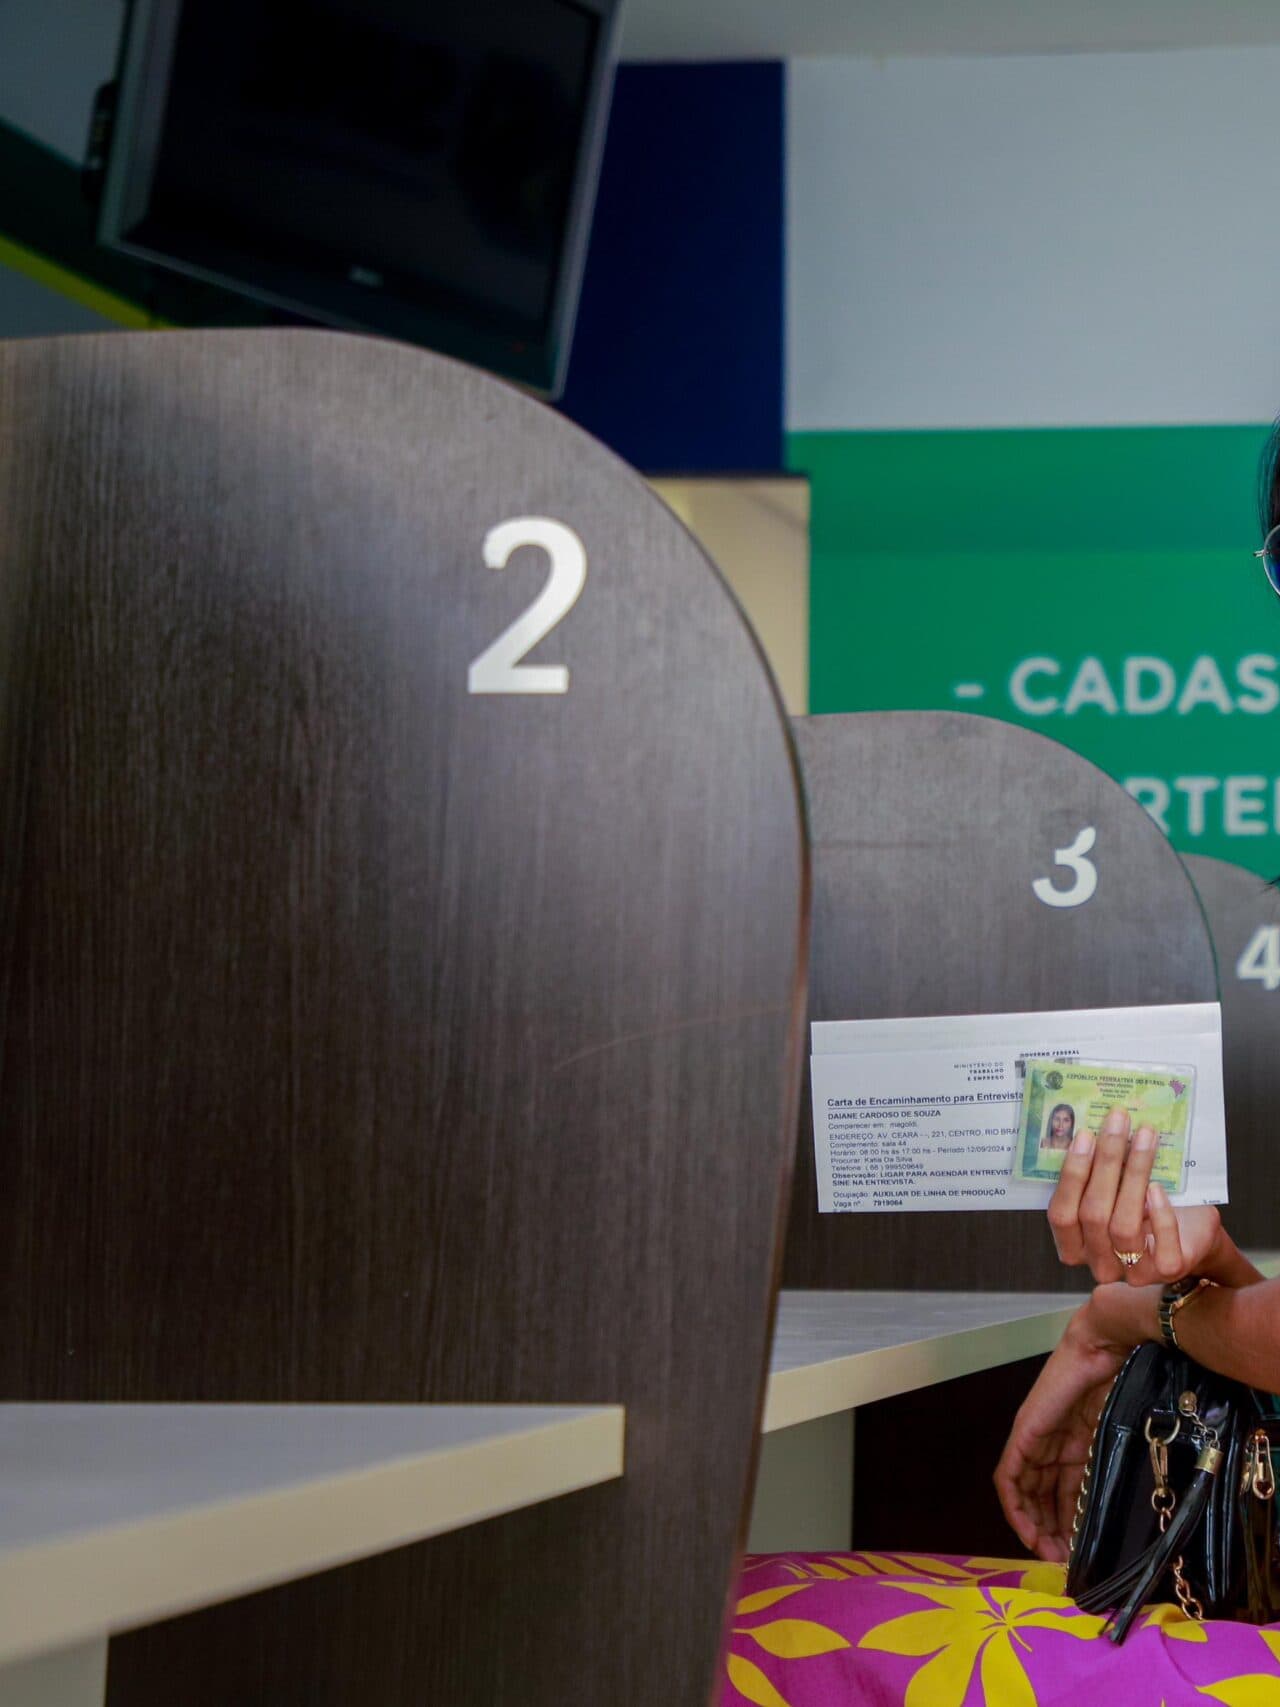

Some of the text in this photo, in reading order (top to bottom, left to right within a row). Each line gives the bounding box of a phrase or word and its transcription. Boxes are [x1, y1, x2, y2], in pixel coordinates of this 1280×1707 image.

[468, 517, 588, 694] 2
[1032, 826, 1099, 909] 3
[827, 1092, 1023, 1107] Carta de Encaminhamento para Entrevista
[827, 1109, 941, 1120] DAIANE CARDOSO DE SOUZA
[905, 1170, 928, 1178] PARA
[929, 1169, 968, 1177] AGENDAR
[970, 1169, 1013, 1177] ENTREVIST
[852, 1179, 864, 1187] NA
[872, 1190, 909, 1198] AUXILIAR
[923, 1189, 947, 1197] LINHA
[948, 1189, 960, 1197] DE
[961, 1187, 1006, 1197] PRODUÇÃO
